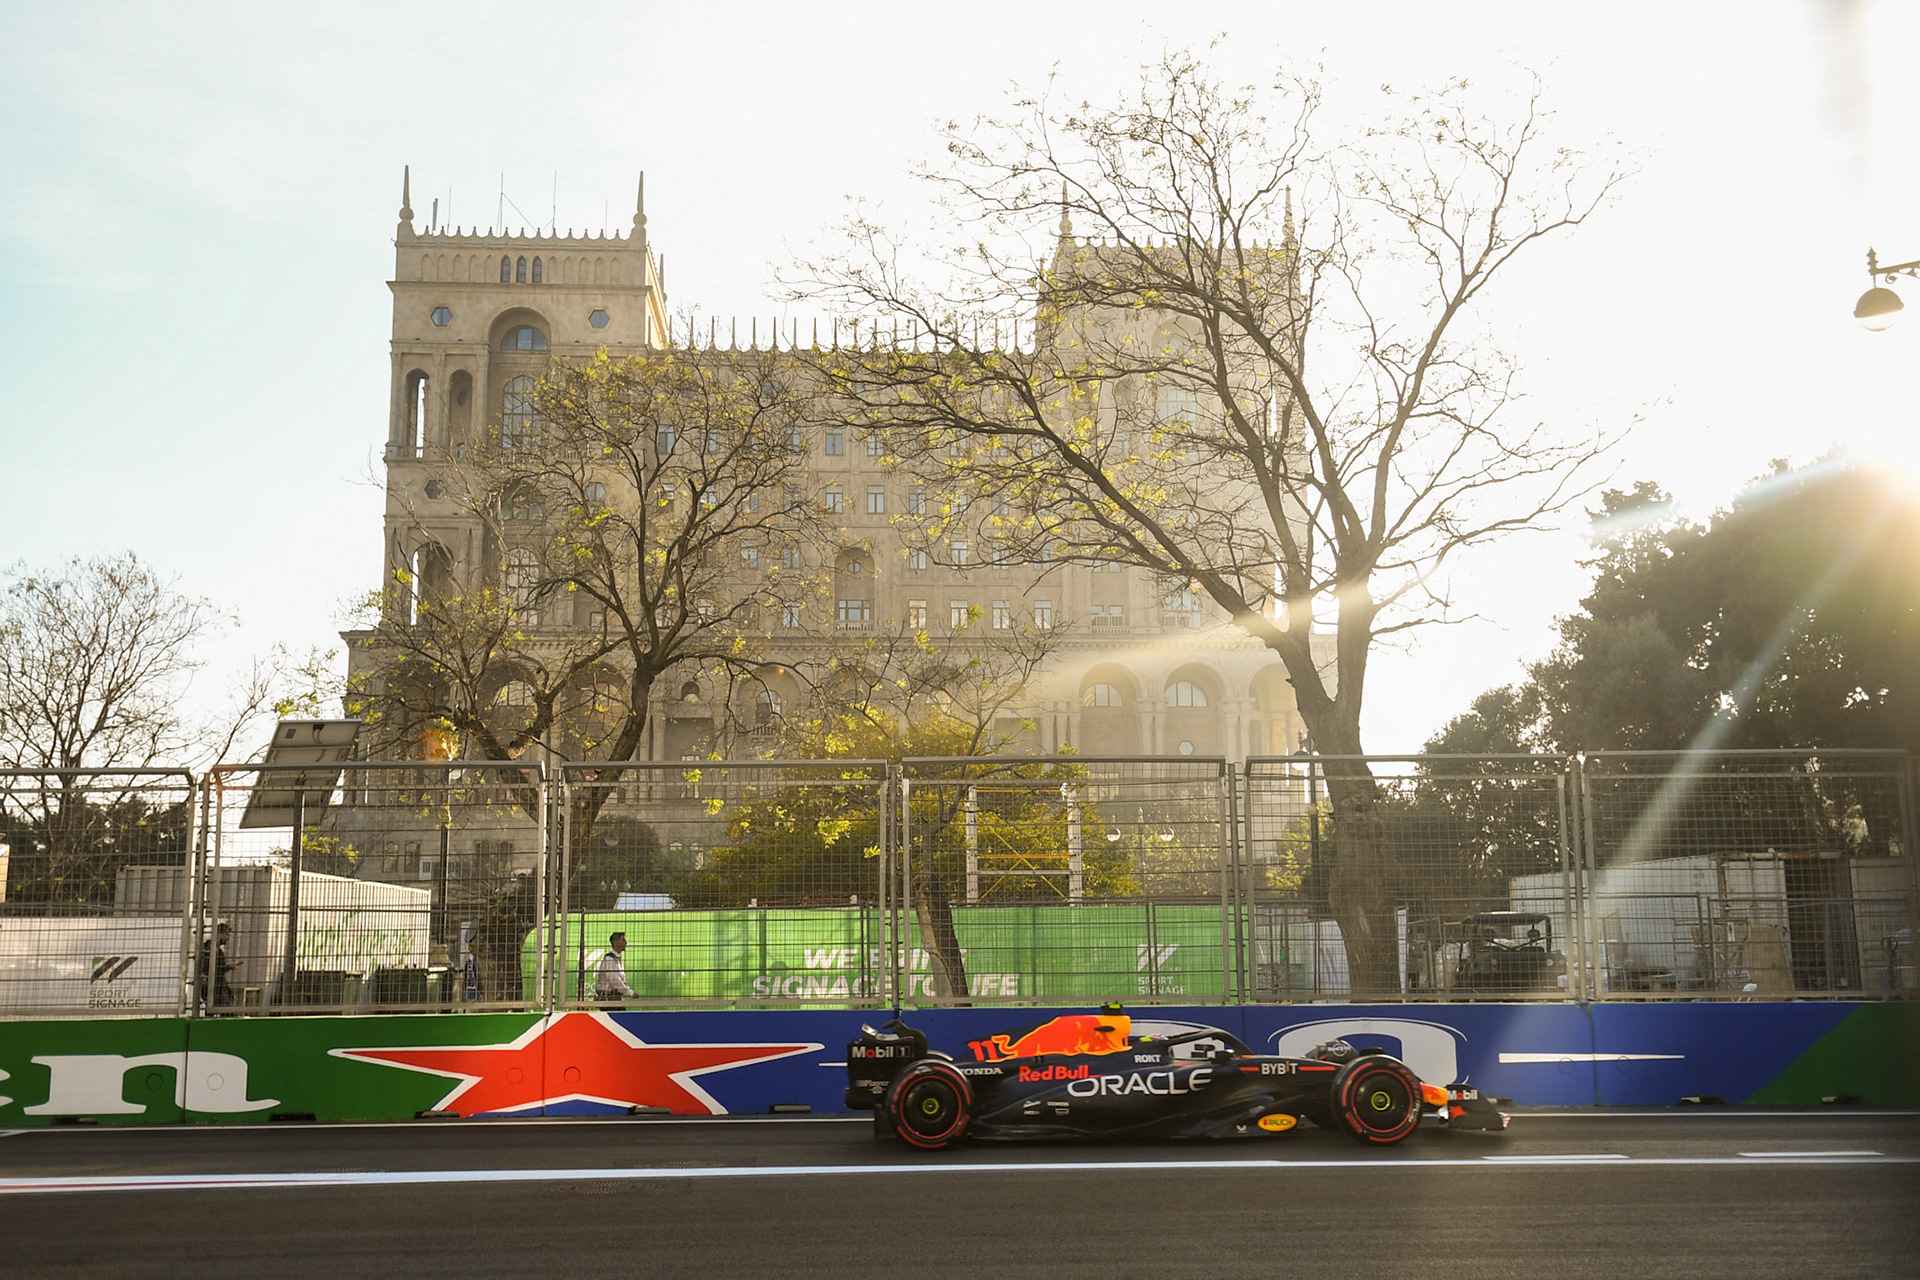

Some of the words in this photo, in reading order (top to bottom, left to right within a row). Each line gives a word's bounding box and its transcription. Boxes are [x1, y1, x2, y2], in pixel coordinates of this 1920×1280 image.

[804, 949, 858, 969] WE
[969, 974, 1020, 996] IFE
[89, 989, 128, 999] SPORT
[88, 999, 141, 1009] SIGNAGE
[852, 1046, 894, 1058] Mobil
[1134, 1054, 1162, 1063] ROKT
[958, 1067, 1004, 1076] ONDA
[1019, 1066, 1053, 1082] Red
[1055, 1065, 1090, 1080] Bull
[1261, 1061, 1298, 1075] BYBIT
[0, 1051, 281, 1115] n
[1067, 1068, 1213, 1097] ORACLE
[1447, 1089, 1478, 1100] Mobil
